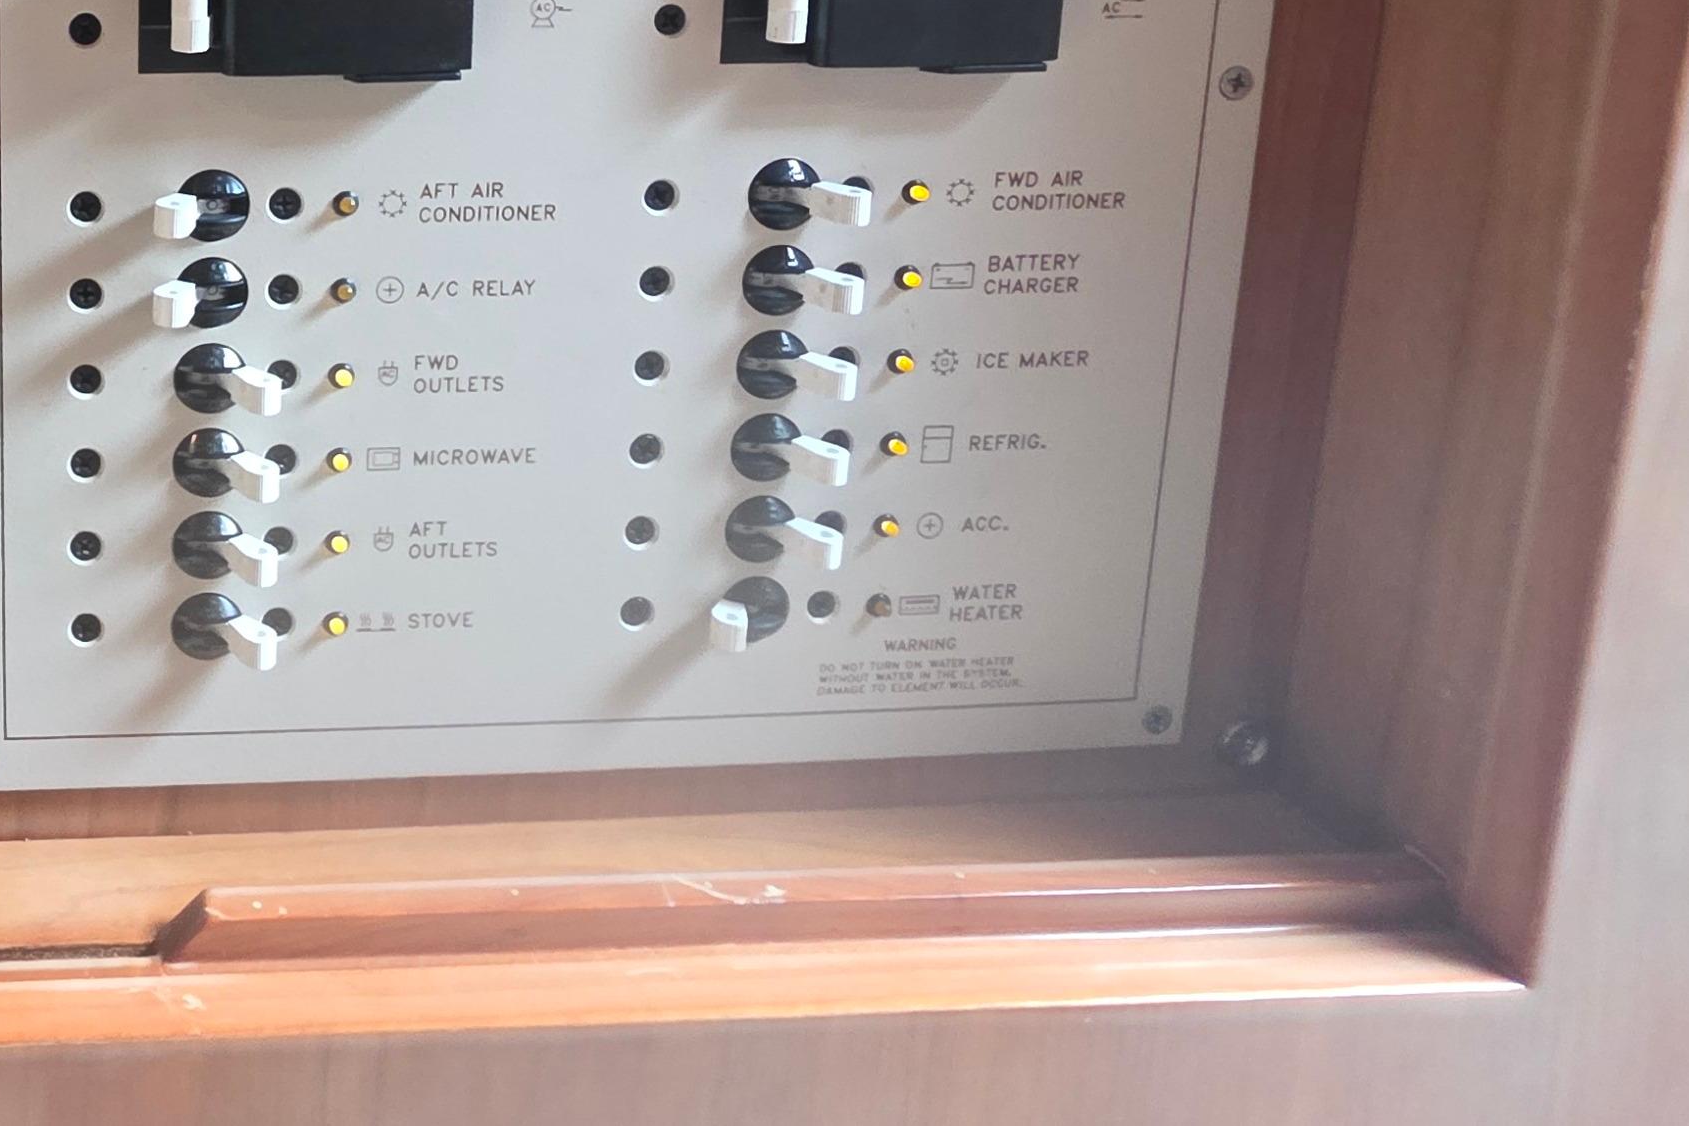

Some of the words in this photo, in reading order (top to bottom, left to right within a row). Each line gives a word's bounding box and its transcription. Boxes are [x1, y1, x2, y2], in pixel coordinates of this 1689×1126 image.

[994, 170, 1039, 188] FWD
[1050, 169, 1084, 187] AIR
[419, 182, 459, 200] AFT
[470, 181, 504, 198] AIR
[992, 191, 1127, 211] CONDITIONER
[418, 203, 556, 224] CONDITIONER
[987, 253, 1081, 273] BATTERY
[416, 280, 459, 301] A/C
[472, 279, 536, 297] RELAY
[983, 275, 1080, 295] CHARGER
[414, 354, 459, 371] FWD
[976, 351, 1010, 370] ICE
[1018, 349, 1090, 368] MAKER
[413, 375, 504, 395] OUTLETS
[968, 432, 1047, 452] REFRIG.
[413, 447, 536, 467] MICROWAVE
[408, 520, 448, 538] AFT
[960, 514, 1010, 533] ACC.
[408, 541, 498, 560] OUTLETS
[952, 583, 1018, 601] WATER
[407, 611, 474, 630] STOVE
[949, 603, 1024, 623] HEATER
[884, 636, 957, 652] WARNING
